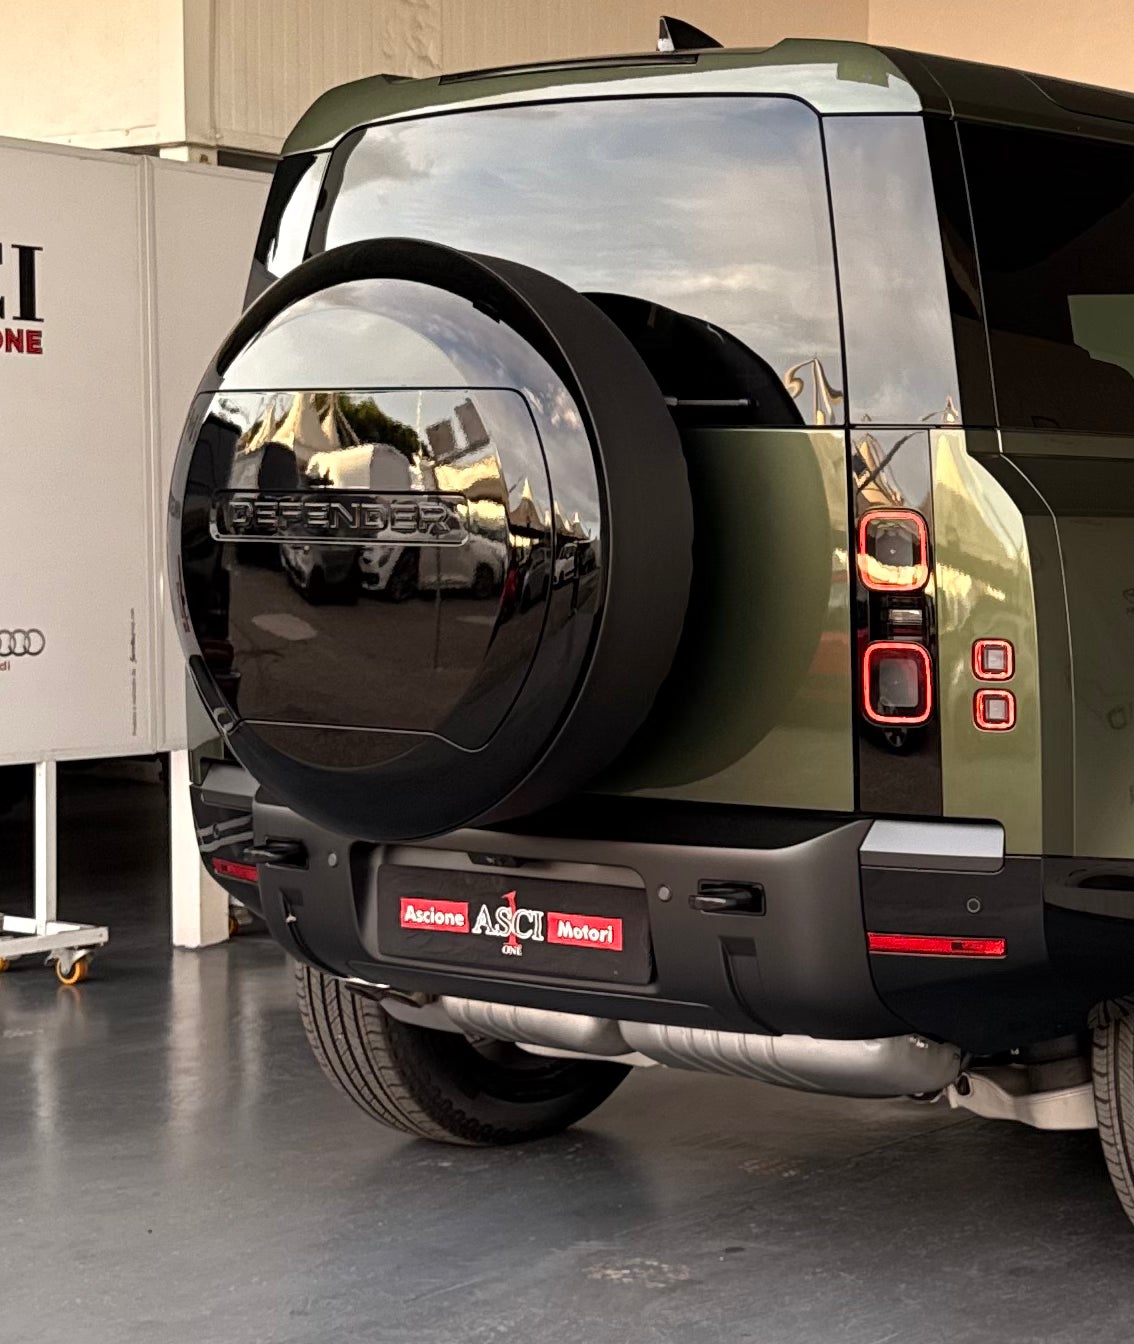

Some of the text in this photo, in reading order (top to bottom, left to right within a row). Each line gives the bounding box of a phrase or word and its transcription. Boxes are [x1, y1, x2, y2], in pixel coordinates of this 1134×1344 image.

[0, 327, 43, 355] NE
[228, 499, 451, 534] DEFENDER
[0, 660, 11, 672] di
[404, 903, 613, 944] Ascione ASCI Motori
[501, 944, 523, 957] ONE
